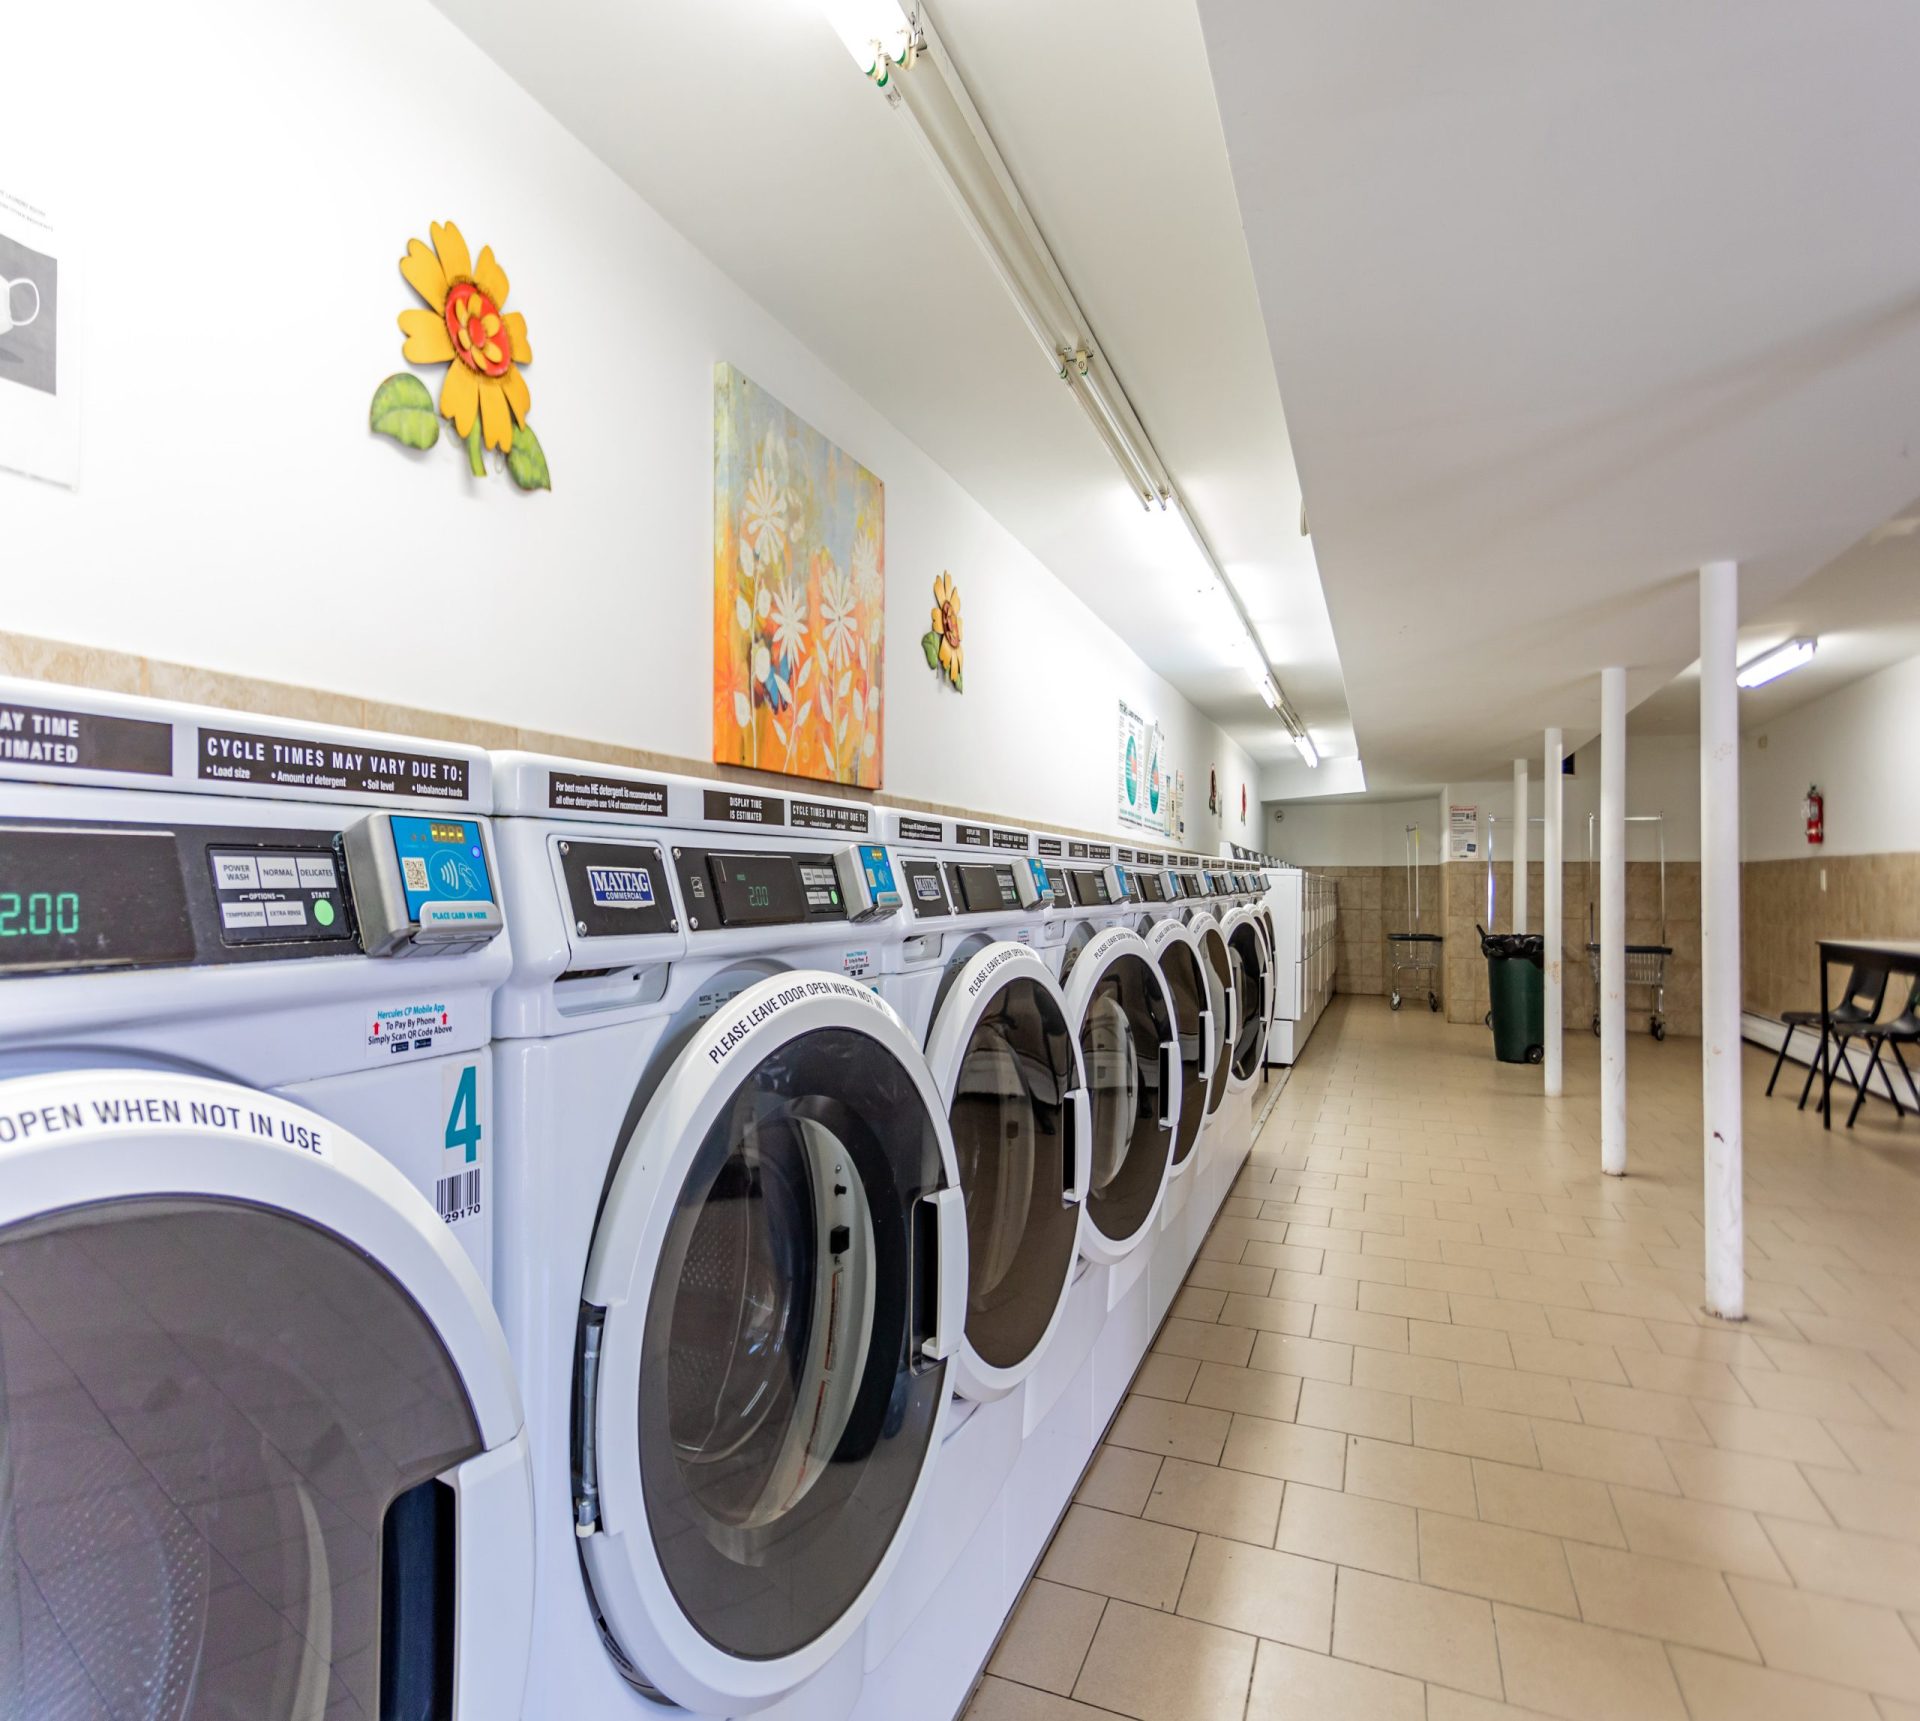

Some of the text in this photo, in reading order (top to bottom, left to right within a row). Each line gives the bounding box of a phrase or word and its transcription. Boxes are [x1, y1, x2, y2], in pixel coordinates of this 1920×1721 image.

[32, 714, 79, 738] TIME
[207, 737, 462, 782] CYCLE TIMES MAY VARY DUE TO:
[213, 765, 251, 779] Load size
[277, 771, 346, 788] Amount of detergent
[367, 779, 394, 792] Soil level
[416, 783, 463, 797] Unbalanced loads
[555, 781, 564, 791] For
[565, 782, 575, 792] best
[590, 783, 599, 795] HE
[599, 785, 624, 798] detergent
[729, 796, 762, 809] DISPLAY TIME
[729, 809, 762, 822] IS ESTIMATED
[792, 804, 808, 816] CYCLE
[809, 806, 825, 818] TIMES
[826, 808, 836, 819] MAY
[837, 810, 848, 820] VARY
[850, 812, 859, 822] DUE
[223, 864, 250, 872] POWER
[263, 869, 294, 877] NORMAL
[300, 869, 333, 877] DELICATES
[227, 873, 249, 881] WASH
[592, 871, 649, 892] MAYTAG
[311, 891, 330, 899] START
[605, 891, 643, 900] COMMERCIAL
[748, 886, 769, 906] 2.00
[0, 892, 79, 936] 2.00
[432, 911, 450, 919] PLACE
[451, 911, 466, 919] CARD
[473, 911, 487, 919] HERE
[1094, 942, 1108, 960] PLEASE
[968, 969, 988, 997] PLEASE
[984, 956, 1002, 974] LEAVE
[998, 950, 1014, 963] DOOR
[377, 1003, 446, 1020] Hercules CP Mobile App
[386, 1016, 436, 1031] To Pay By Phone
[708, 1019, 750, 1064] PLEASE
[746, 997, 780, 1027] LEAVE
[777, 985, 807, 1007] DOOR
[806, 982, 832, 996] OPEN
[830, 982, 858, 998] WHEN
[857, 988, 873, 1005] NOT
[368, 1033, 391, 1046] Simply
[391, 1030, 407, 1042] Scan
[407, 1029, 417, 1040] QR
[417, 1027, 433, 1037] Code
[433, 1025, 453, 1036] Above
[445, 1066, 482, 1163] 4
[0, 1099, 322, 1156] OPEN WHEN NOT IN USE
[441, 1203, 481, 1224] 29170
